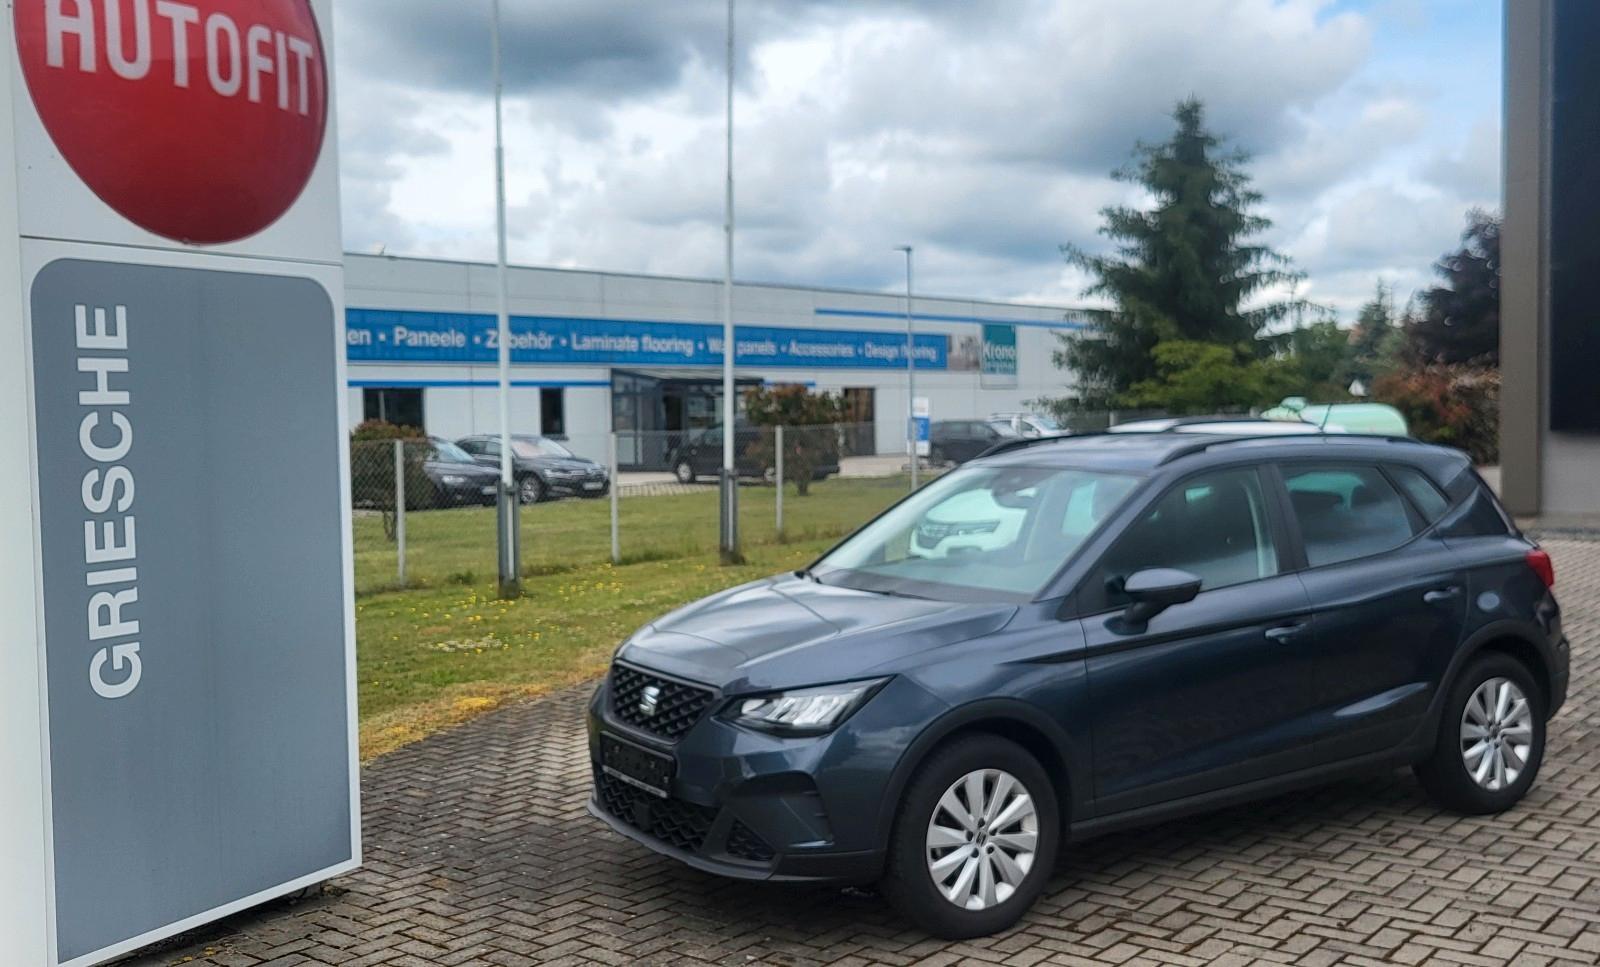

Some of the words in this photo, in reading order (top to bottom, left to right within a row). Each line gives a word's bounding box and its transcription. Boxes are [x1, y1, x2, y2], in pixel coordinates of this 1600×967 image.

[45, 0, 313, 116] AUTOFIT
[394, 327, 466, 348] Paneele
[485, 329, 554, 350] Zbehör
[572, 333, 639, 352] Laminate
[641, 334, 694, 357] flooring
[74, 304, 142, 698] GRIESCHE
